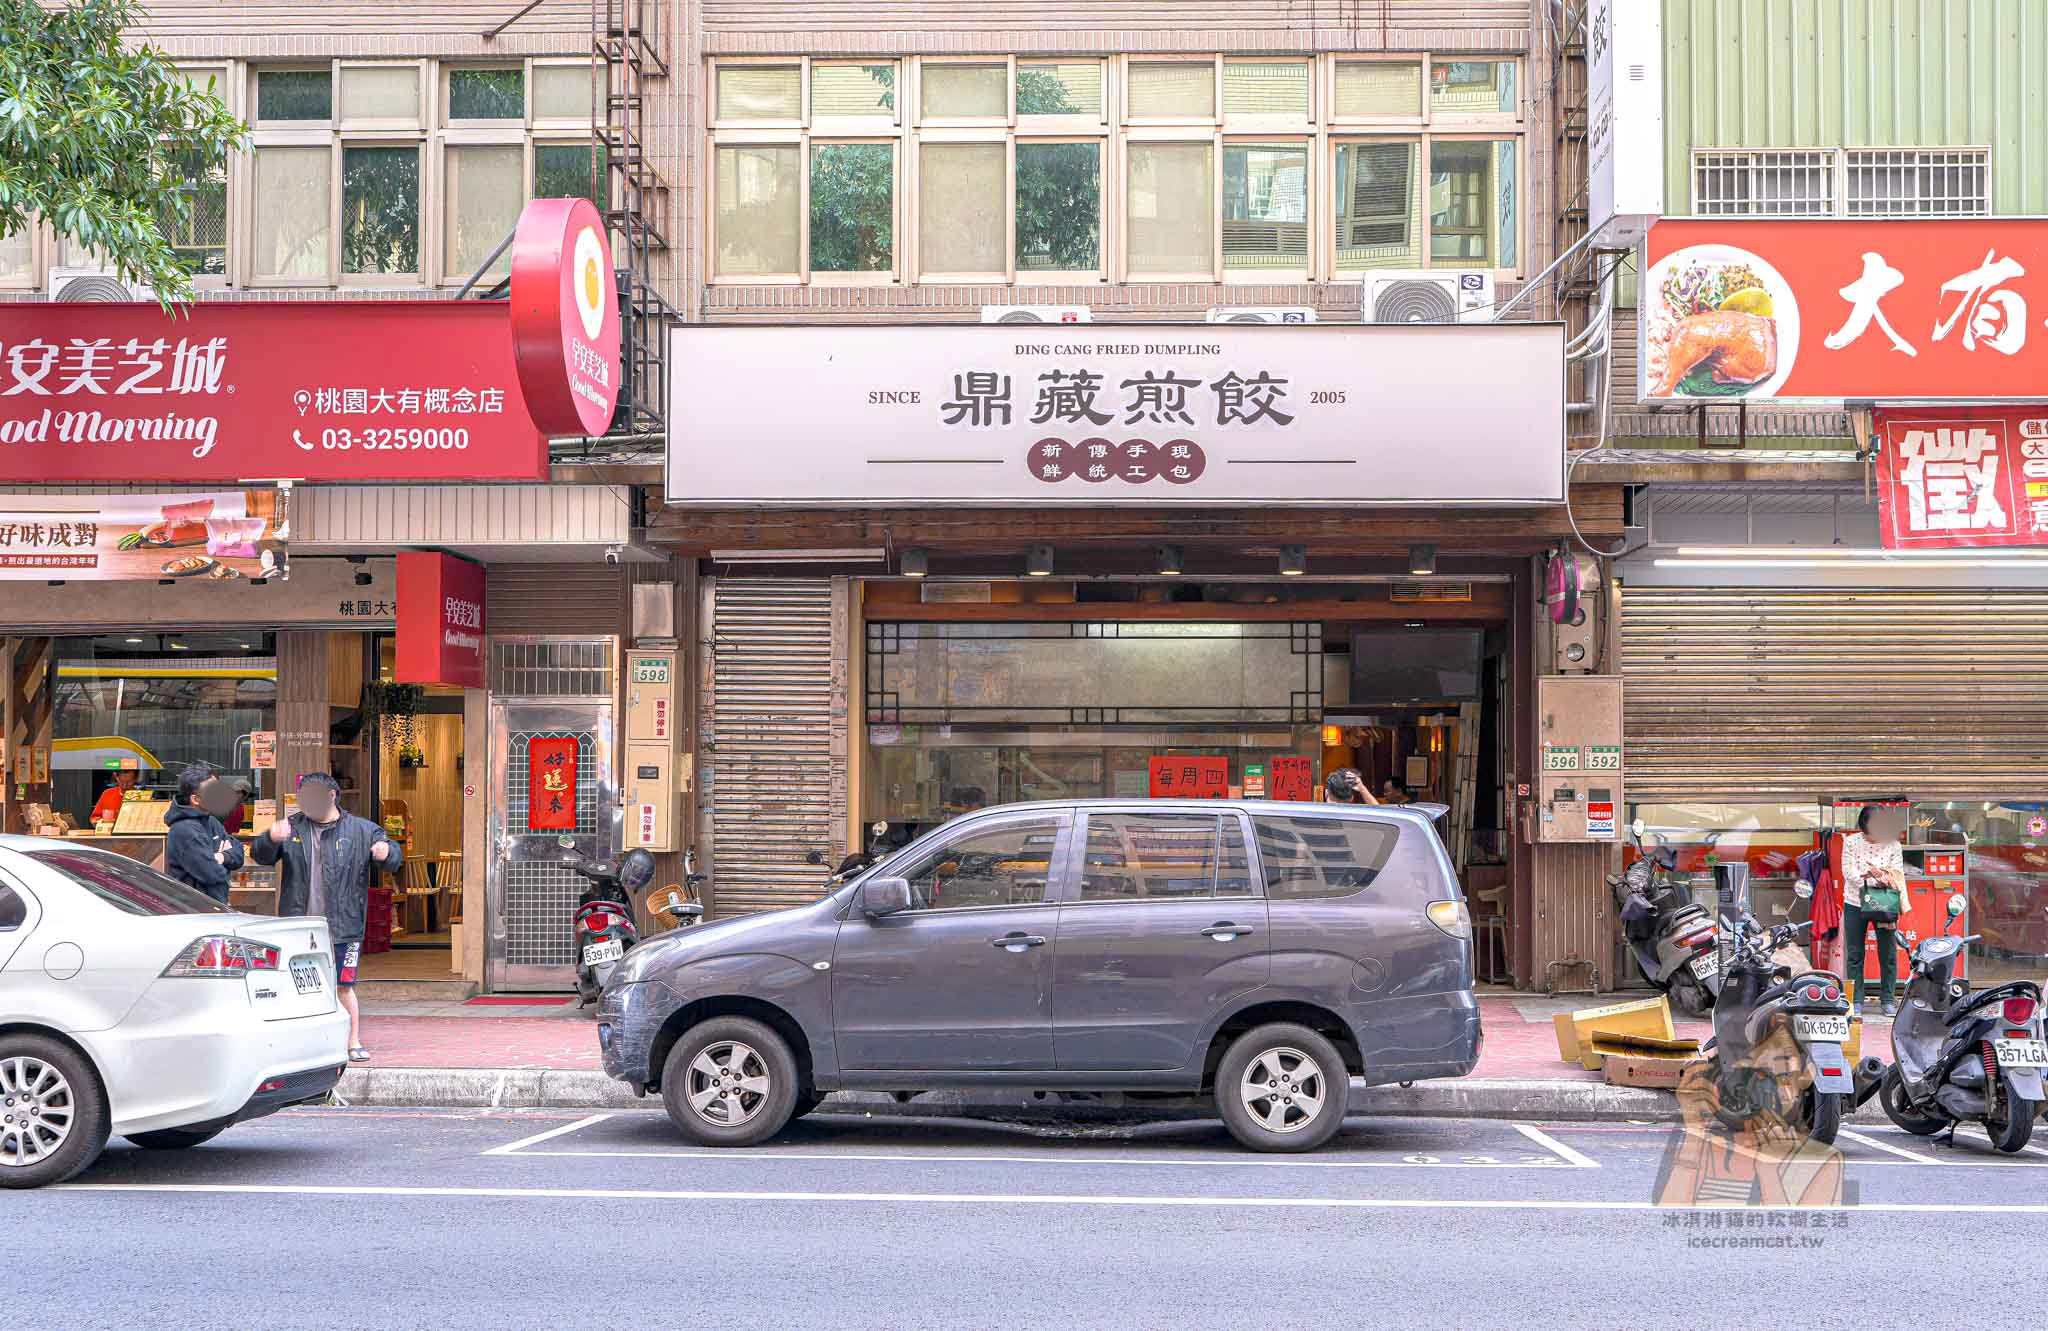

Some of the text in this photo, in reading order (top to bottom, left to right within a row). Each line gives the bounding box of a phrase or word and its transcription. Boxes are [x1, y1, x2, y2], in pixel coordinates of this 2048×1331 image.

[1824, 249, 2048, 357] 大有
[1016, 345, 1221, 355] DING CANG FRIED DUMPLING
[0, 337, 227, 395] 安美芝城
[315, 387, 505, 415] 桃園大有概念店
[869, 391, 920, 404] SINCE
[941, 369, 1294, 426] 鼎藏煎餃
[1310, 391, 1346, 404] 2005
[55, 411, 218, 459] Morning
[2027, 421, 2048, 436] 儲
[322, 428, 469, 451] 03-3259000
[0, 523, 99, 546] 好味成對
[640, 669, 666, 681] 598
[1551, 756, 1577, 768] 596
[1591, 756, 1617, 768] 592
[1157, 764, 1224, 788] 每周四
[1998, 1048, 2048, 1063] 357-LGA
